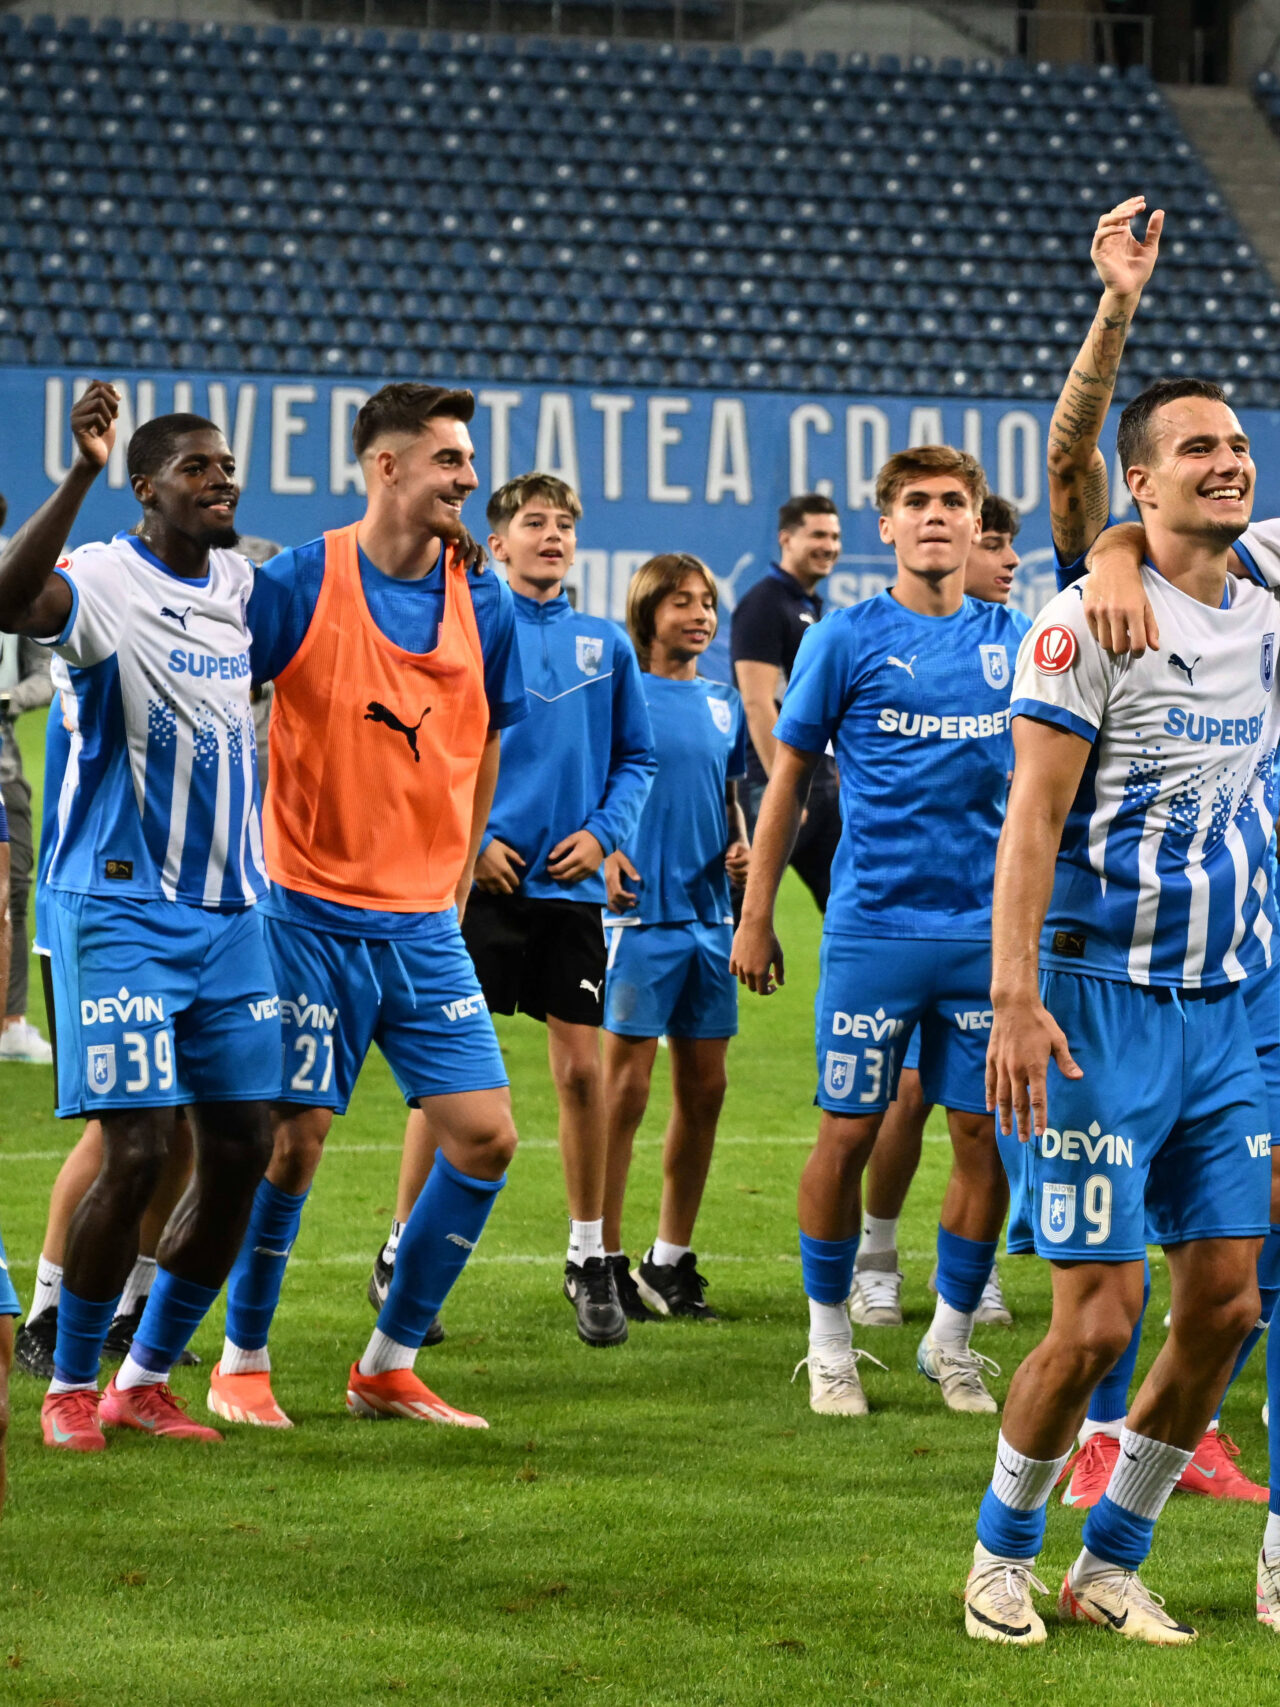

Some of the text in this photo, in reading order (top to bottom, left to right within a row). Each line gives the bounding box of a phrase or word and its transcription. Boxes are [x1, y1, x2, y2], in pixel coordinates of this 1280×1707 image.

[168, 648, 250, 680] SUPERB
[877, 707, 1012, 739] SUPERBET
[81, 986, 165, 1026] DEVIN
[279, 993, 338, 1030] EVIN
[123, 1030, 173, 1093] 39
[291, 1034, 334, 1092] 27
[860, 1046, 895, 1104] 3
[1041, 1120, 1134, 1169] DEVIN
[1083, 1173, 1113, 1246] 9
